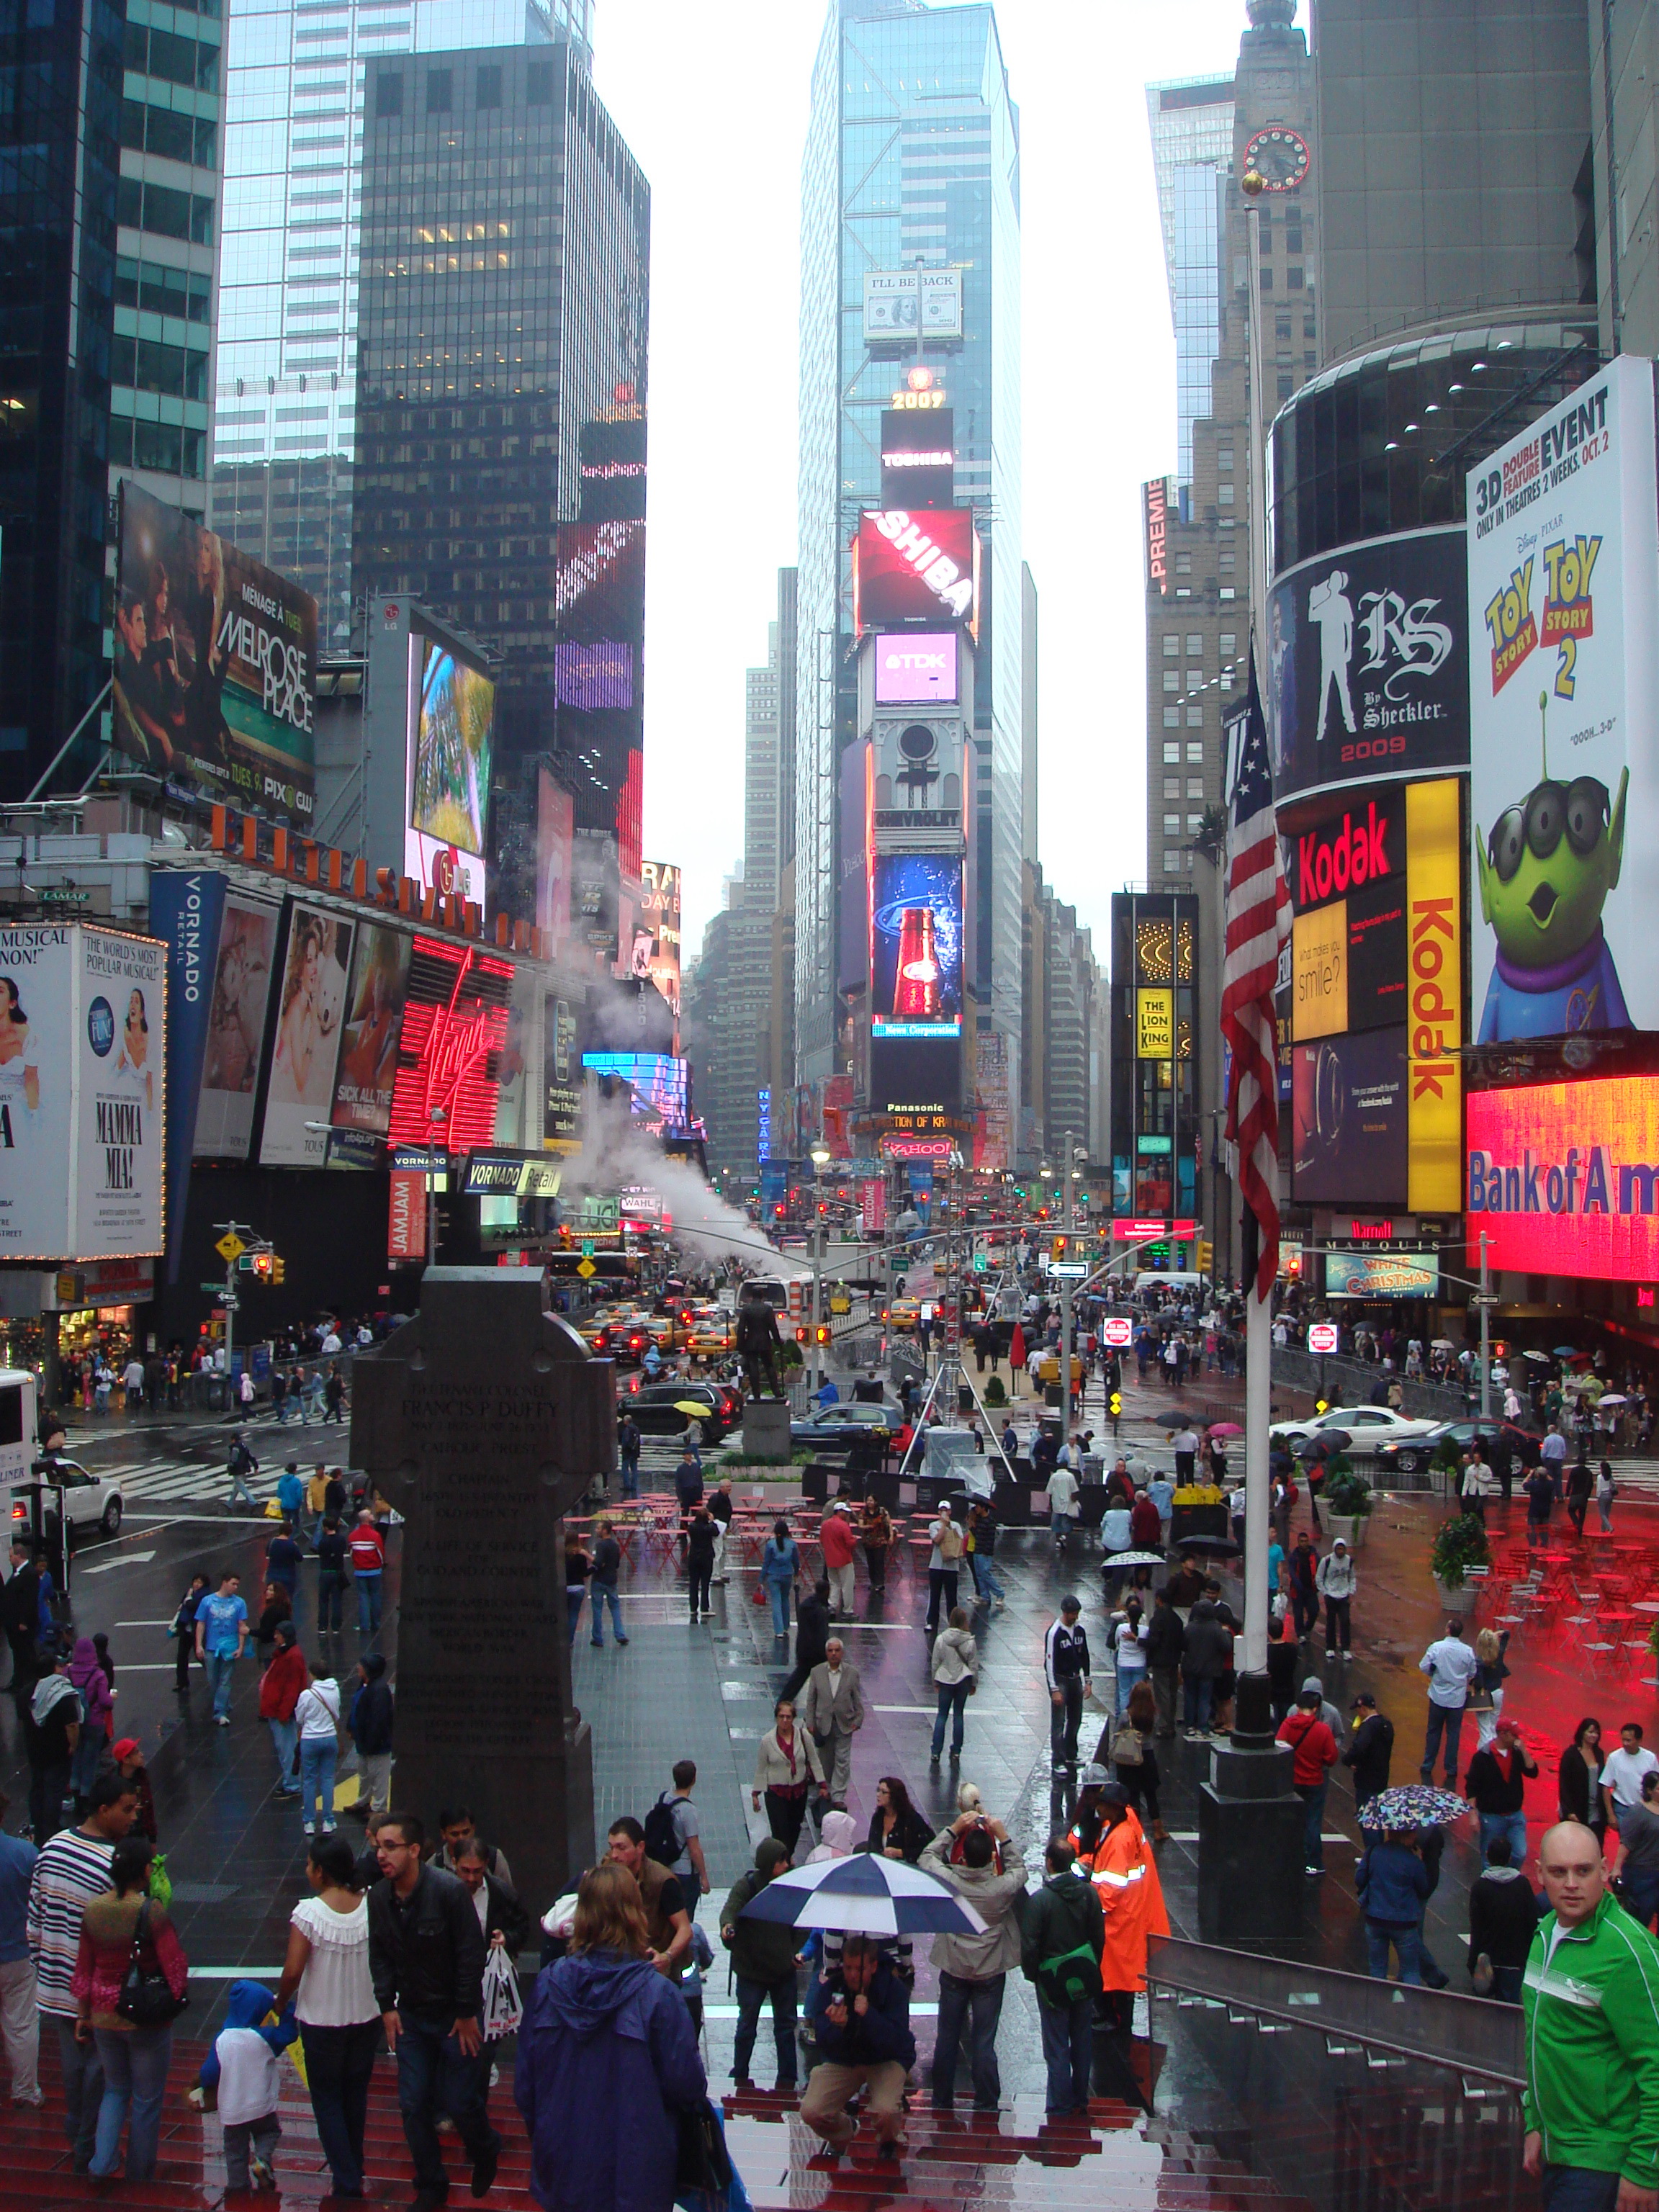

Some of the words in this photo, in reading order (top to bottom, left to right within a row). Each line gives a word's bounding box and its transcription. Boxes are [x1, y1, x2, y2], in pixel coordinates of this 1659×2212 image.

[872, 279, 895, 288] I'LL
[899, 278, 916, 287] BE
[892, 392, 944, 410] 2009
[1540, 385, 1608, 472] EVENT
[882, 451, 953, 467] TOSHIBA
[1503, 438, 1539, 480] DOUBLE
[1477, 516, 1493, 540] ONLY
[1496, 507, 1503, 526] IN
[1506, 479, 1540, 521] THEATRES
[1543, 474, 1548, 494] 2
[1582, 437, 1600, 466] OCT.
[1602, 431, 1609, 453] 2
[1503, 458, 1539, 499] FEATURE
[1476, 469, 1501, 516] 3D
[1541, 513, 1563, 537] PIXAR
[1543, 534, 1604, 608] TOY
[1485, 552, 1535, 657] TOY
[1546, 608, 1588, 631] STORY
[217, 611, 307, 693] MELROSE
[898, 654, 947, 668] TDK
[1496, 624, 1532, 677] STORY
[1554, 633, 1577, 701] 2
[264, 669, 313, 733] PLACE
[1364, 692, 1380, 706] By
[1363, 701, 1442, 729] Sheckler
[1341, 735, 1406, 763] 2009
[1299, 801, 1391, 905] Kodak
[1, 930, 68, 947] MUSICAL
[185, 876, 201, 1002] VORNADO
[87, 954, 122, 974] POPULAR
[103, 940, 135, 961] WORLD'S
[138, 949, 158, 965] MOST
[1299, 956, 1340, 1002] smile?
[1145, 1002, 1164, 1012] THE
[1413, 898, 1455, 1101] Kodak
[885, 1025, 906, 1035] News
[909, 1025, 959, 1037] Corporation
[1142, 1014, 1169, 1030] LION
[1141, 1032, 1169, 1049] KING
[338, 1085, 359, 1102] SICK
[361, 1089, 374, 1102] ALL
[377, 1093, 391, 1105] THE
[96, 1102, 142, 1145] MAMMA
[917, 1116, 928, 1128] OF
[305, 1140, 323, 1152] TOUS
[884, 1142, 951, 1156] YAHOO!
[105, 1148, 134, 1189] MIA!
[469, 1165, 520, 1187] VORNADO
[526, 1169, 555, 1188] Retail
[1470, 1149, 1545, 1213] Bank
[1547, 1148, 1581, 1215] of
[626, 1199, 653, 1208] WAHL
[866, 1184, 875, 1230] WELCOME
[393, 1182, 410, 1253] JAMJAM
[1326, 1241, 1439, 1251] MARQUIS
[1362, 1255, 1412, 1272] WHITE
[1346, 1269, 1431, 1295] CHRISTMAS
[402, 1400, 474, 1416] FRANCIS
[498, 1401, 560, 1418] DUFFY
